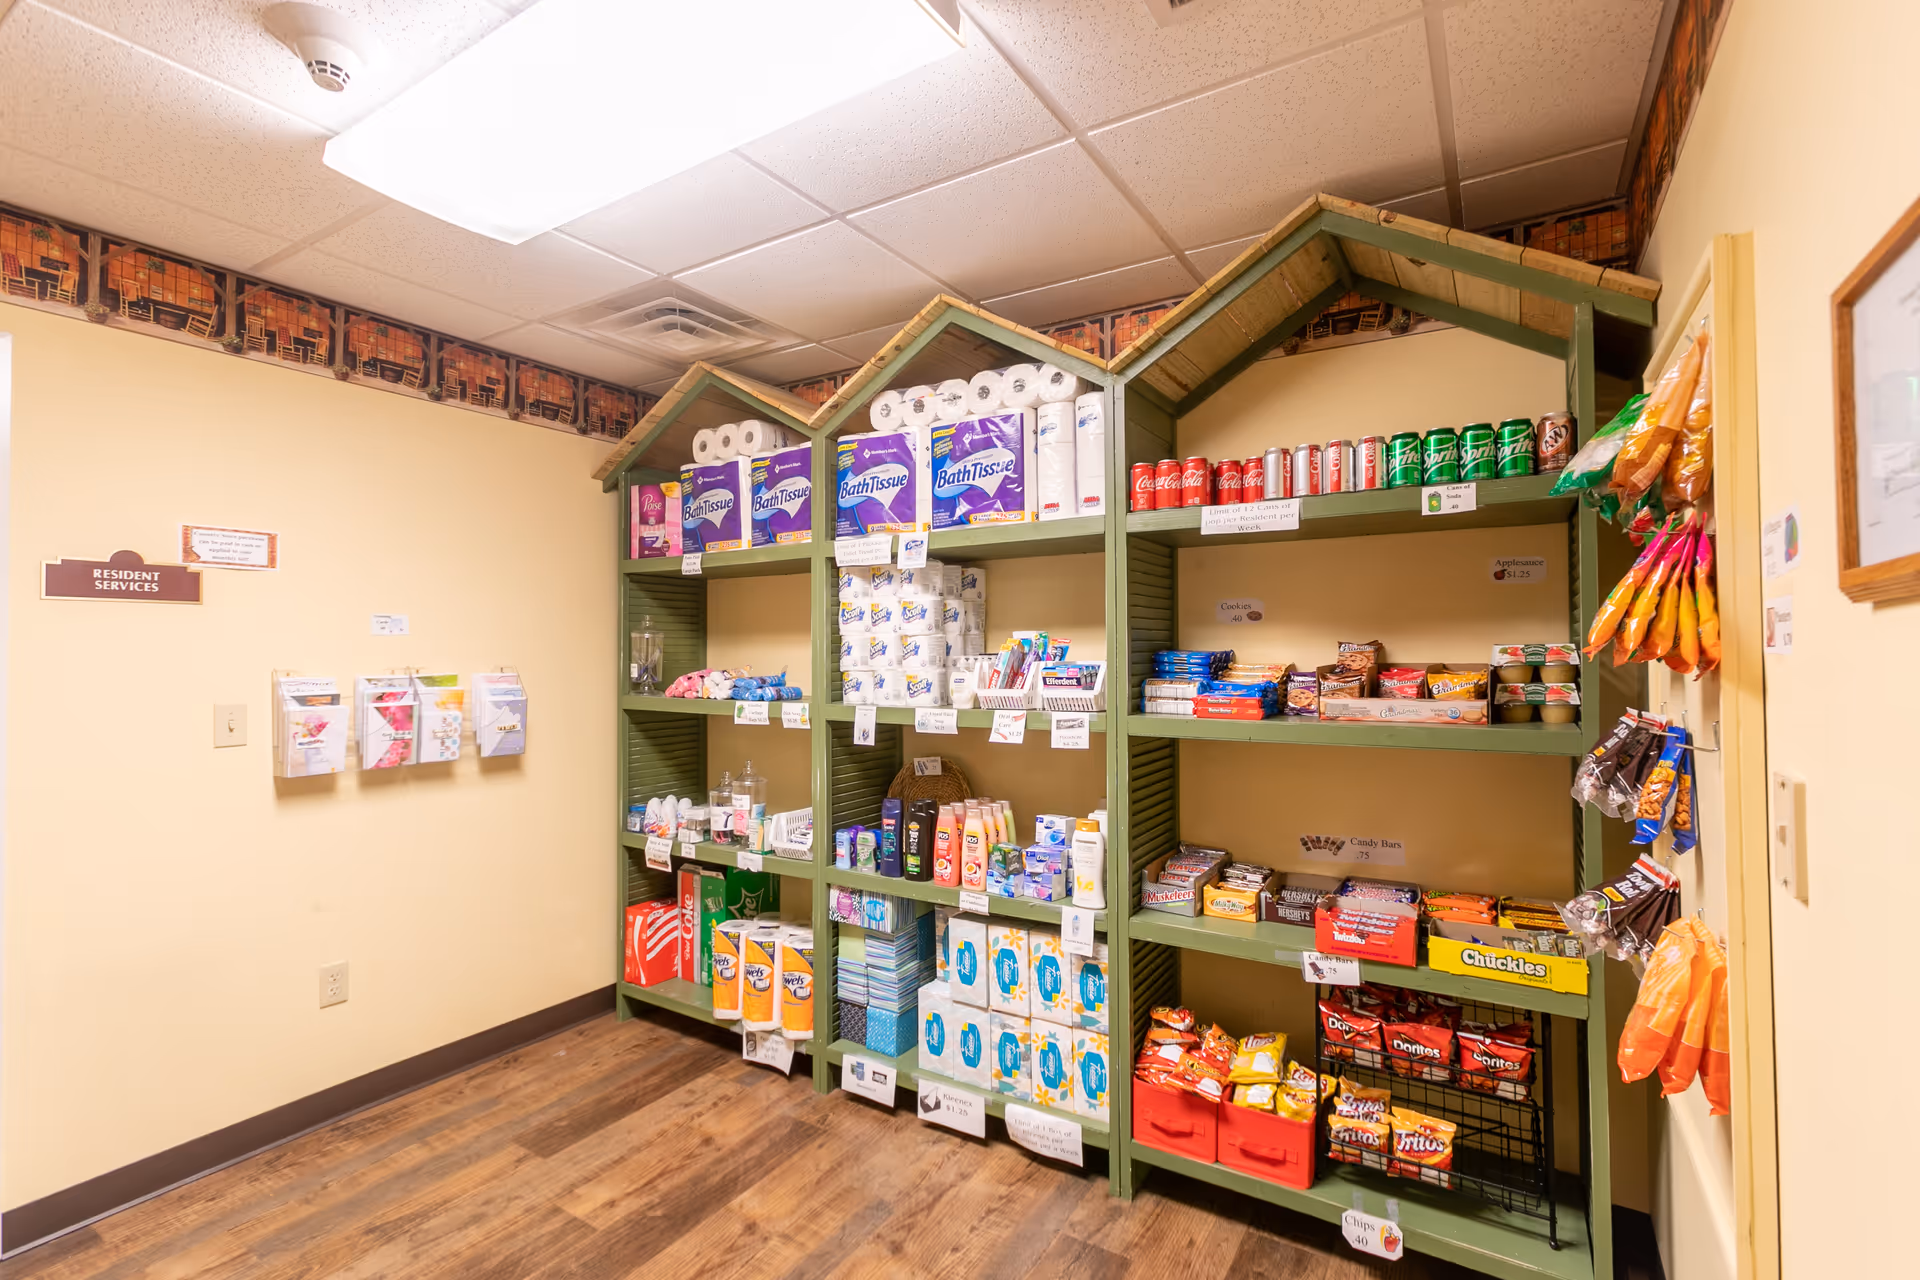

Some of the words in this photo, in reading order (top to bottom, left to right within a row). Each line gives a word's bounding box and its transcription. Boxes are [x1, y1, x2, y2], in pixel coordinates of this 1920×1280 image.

[642, 494, 662, 512] Poise
[1240, 513, 1277, 522] Resident
[1238, 524, 1262, 532] Week
[1495, 558, 1544, 568] Applesauce
[93, 568, 160, 581] RESIDENT
[1506, 570, 1530, 579] $1.25
[94, 580, 159, 592] SERVICES
[1220, 602, 1252, 610] Cookies
[1230, 614, 1243, 623] .40
[1045, 677, 1078, 686] Efferdent
[1350, 838, 1379, 848] Candy
[1381, 839, 1402, 848] Bars
[1356, 851, 1370, 860] .75
[1147, 889, 1196, 904] Musketeers
[680, 893, 693, 940] Coke
[1278, 908, 1310, 921] HERSHEY'S
[682, 940, 690, 960] Diet
[1308, 954, 1334, 964] Candy
[1335, 956, 1354, 964] Bars
[1393, 1040, 1440, 1059] Doritos
[1473, 1053, 1521, 1072] Doritos
[943, 1093, 973, 1108] Kleenex
[946, 1104, 968, 1117] $1.25
[1396, 1129, 1445, 1152] Fritos
[1344, 1215, 1376, 1232] Chips
[1352, 1236, 1368, 1247] .40
